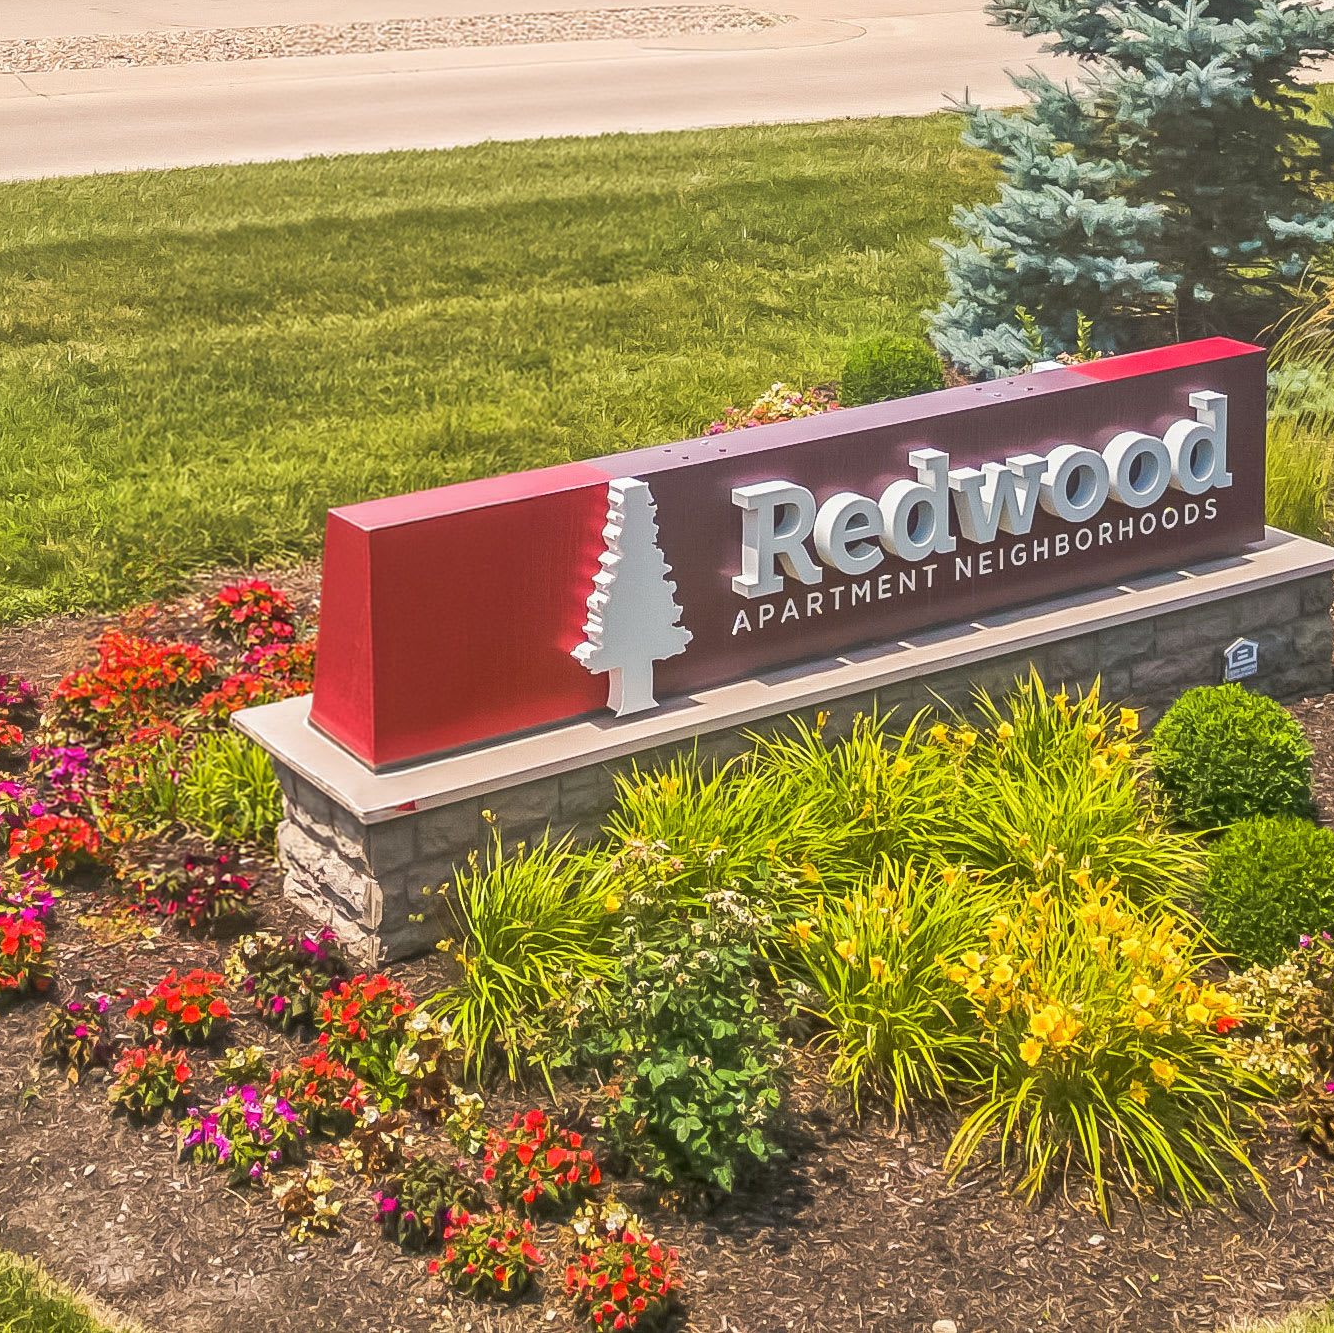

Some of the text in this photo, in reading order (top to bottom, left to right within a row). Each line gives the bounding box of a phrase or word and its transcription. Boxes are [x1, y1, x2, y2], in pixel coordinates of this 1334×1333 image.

[731, 390, 1233, 599] Redwood
[731, 498, 1218, 636] APARTMENT NEIGHBORHOODS
